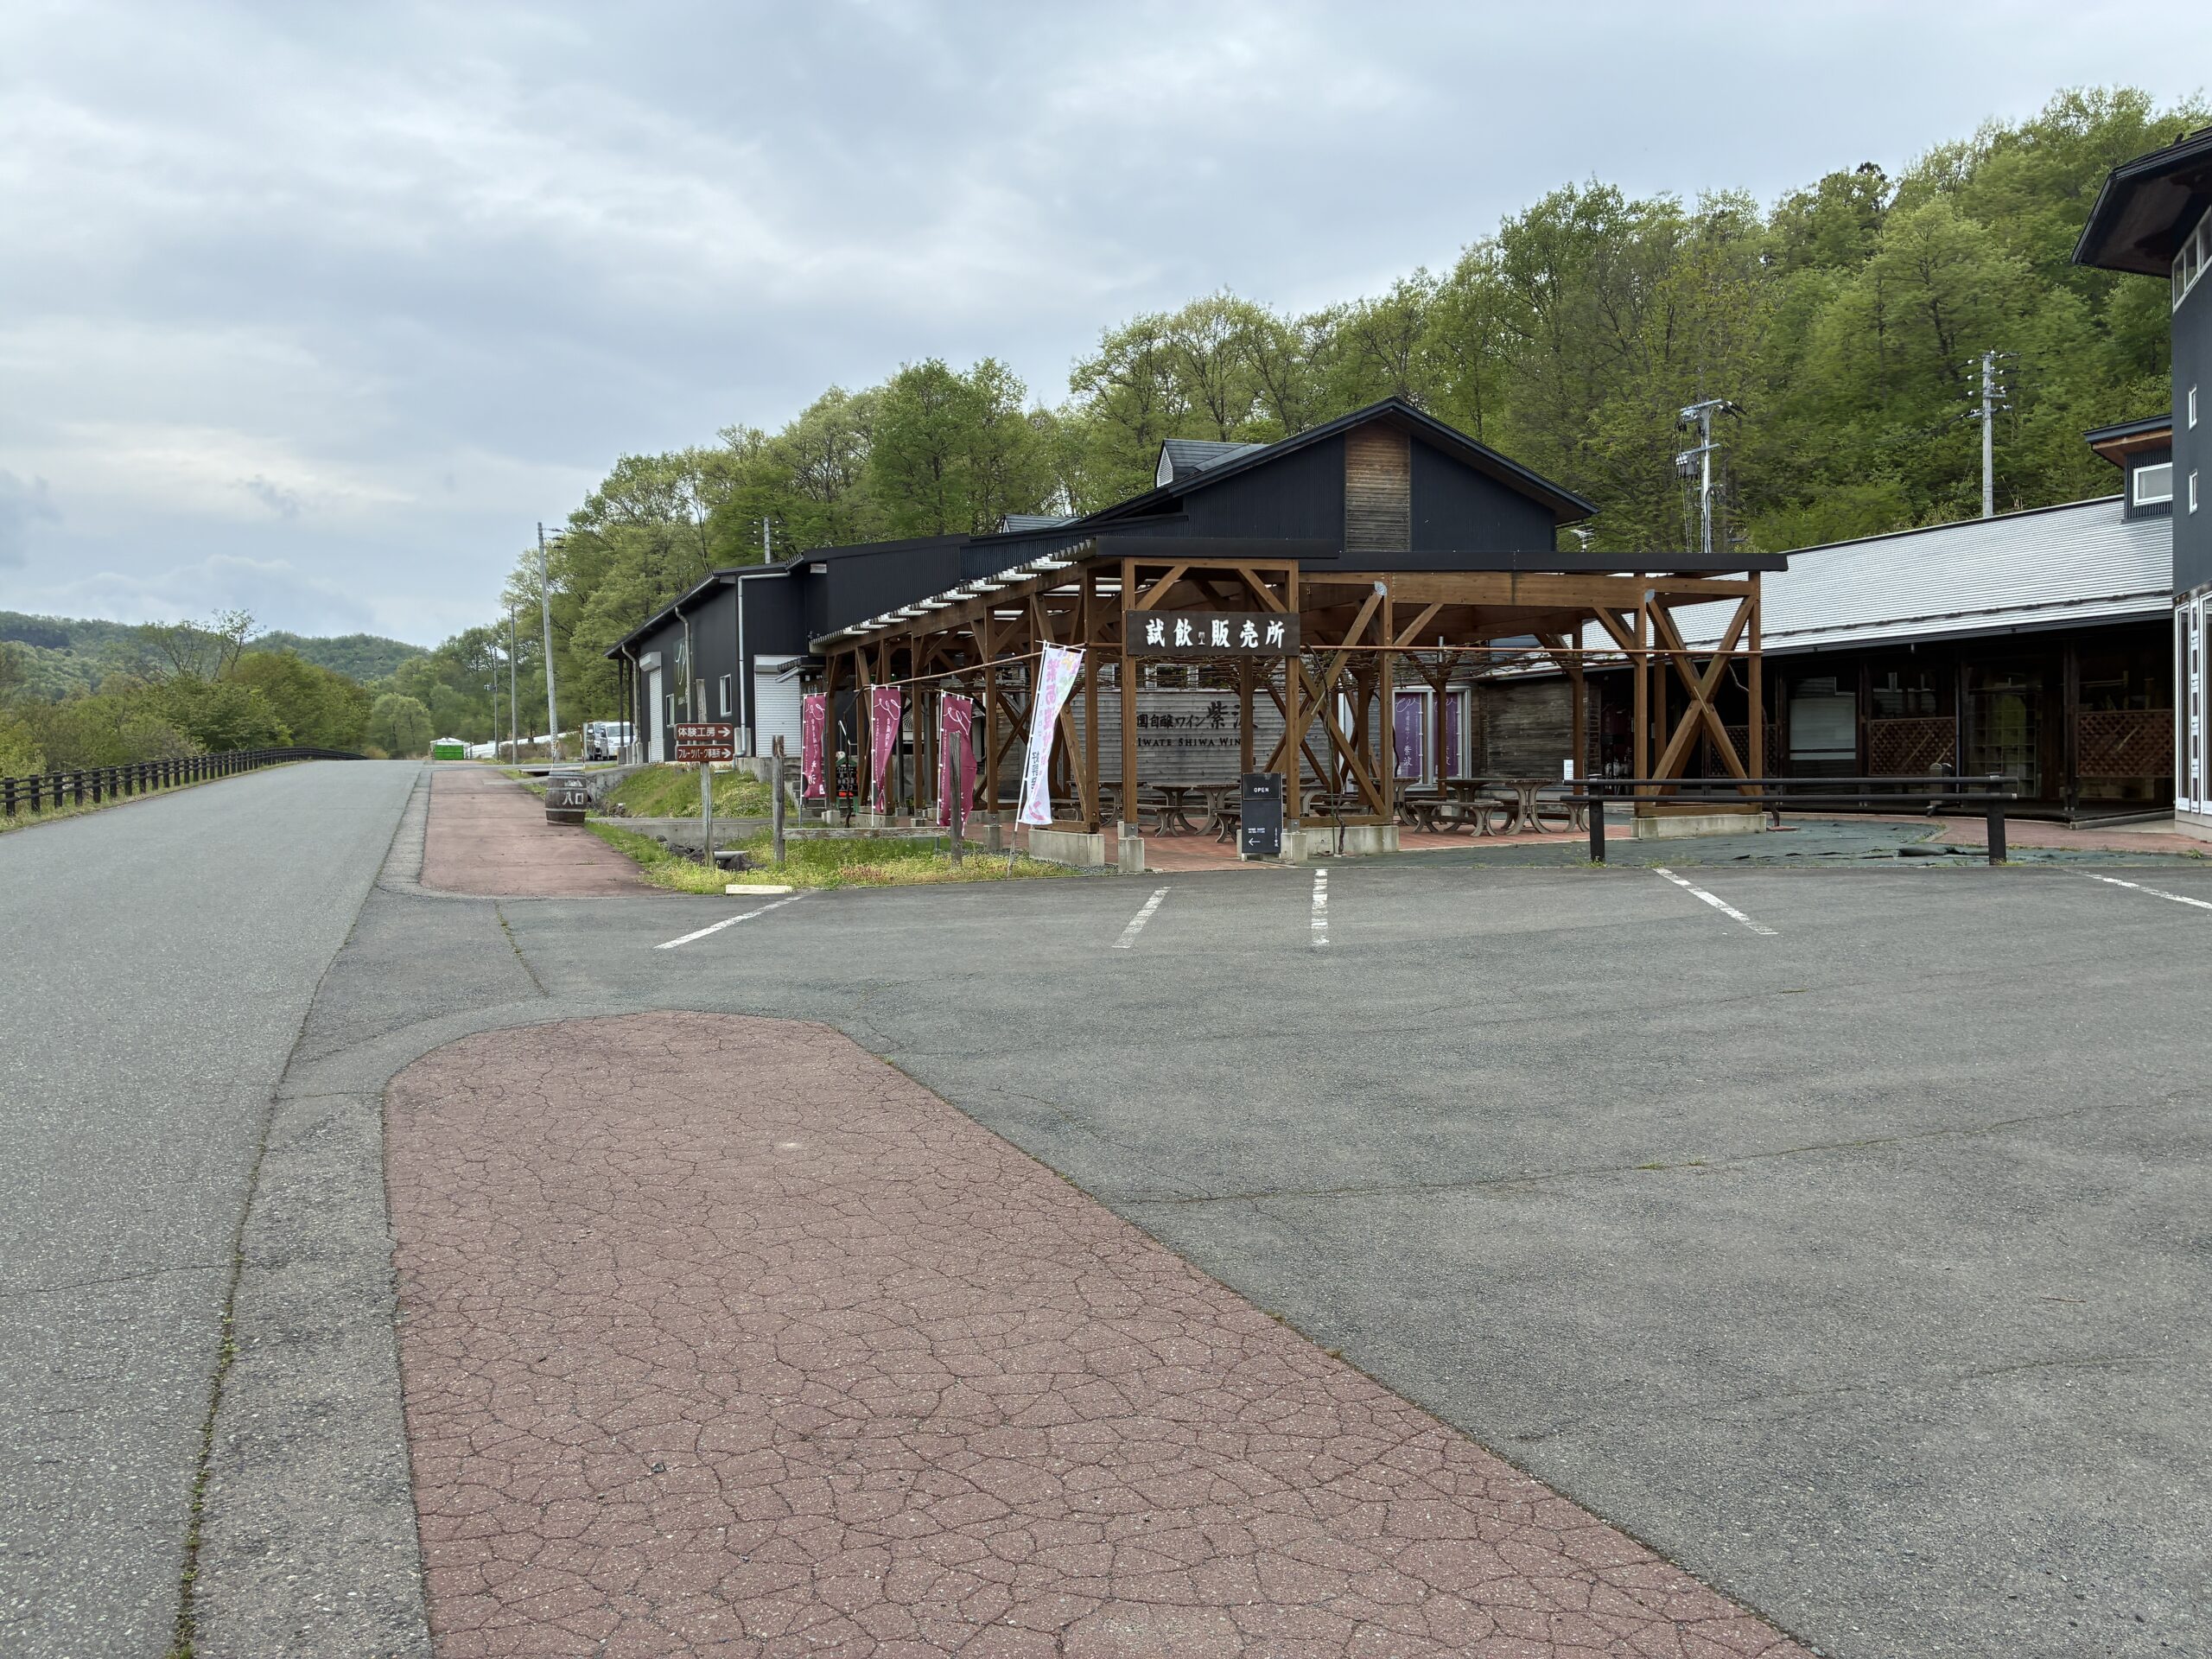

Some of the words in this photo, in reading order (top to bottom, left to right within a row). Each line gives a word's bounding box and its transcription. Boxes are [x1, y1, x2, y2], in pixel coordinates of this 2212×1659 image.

[677, 727, 715, 737] 体験工房
[1137, 737, 1173, 747] IWATE
[1178, 737, 1215, 747] SHIWA
[1219, 737, 1242, 747] WIN
[562, 791, 584, 805] 入口
